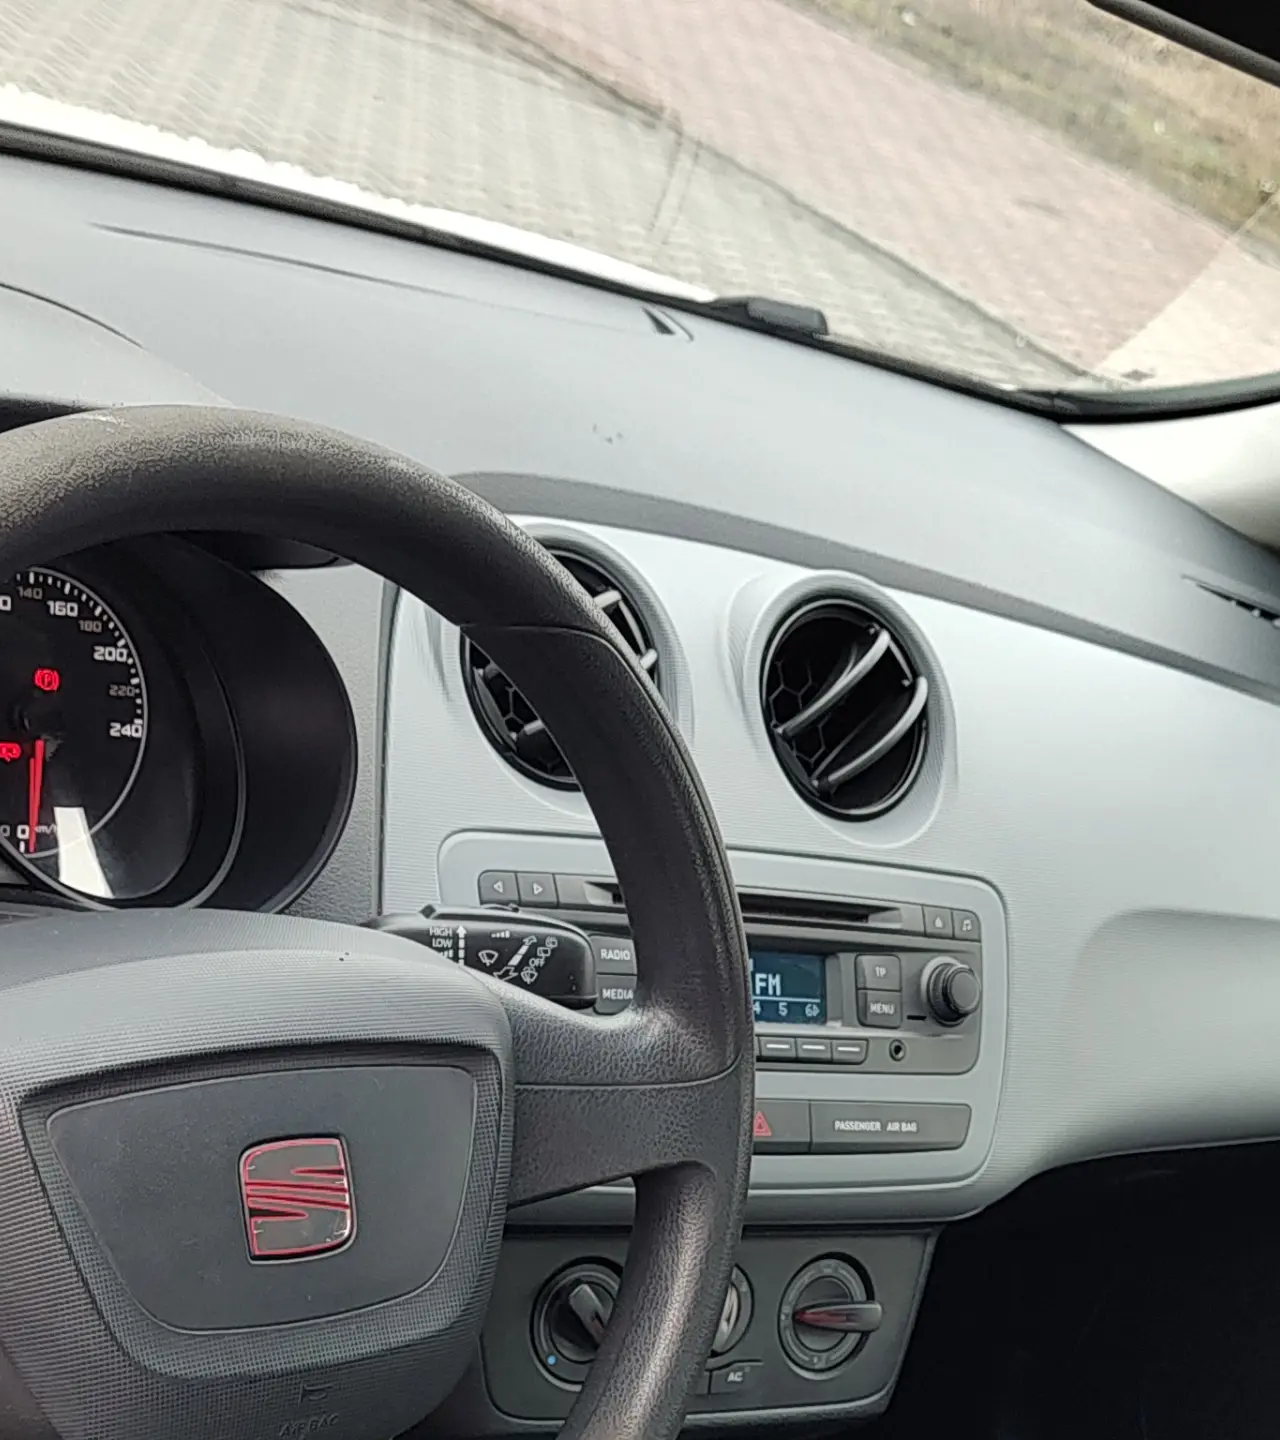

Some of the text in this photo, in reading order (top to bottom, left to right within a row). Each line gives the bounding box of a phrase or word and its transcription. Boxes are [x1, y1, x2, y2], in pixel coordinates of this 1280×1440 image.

[17, 586, 44, 600] 140
[46, 600, 79, 618] 160
[78, 619, 103, 633] 180
[93, 645, 128, 662] 200
[108, 684, 135, 697] 220
[109, 721, 143, 738] 240
[16, 823, 30, 840] 0
[429, 927, 453, 937] HIGH
[431, 938, 453, 948] LOW
[600, 948, 631, 961] RADIO
[529, 957, 546, 968] OFF
[874, 966, 887, 978] TP
[754, 972, 782, 997] FM
[602, 988, 634, 1000] MEDIA
[778, 1002, 788, 1017] 5
[869, 1003, 895, 1016] MENU
[834, 1119, 918, 1133] PASSENGER AIR BAG
[727, 1371, 743, 1383] AC
